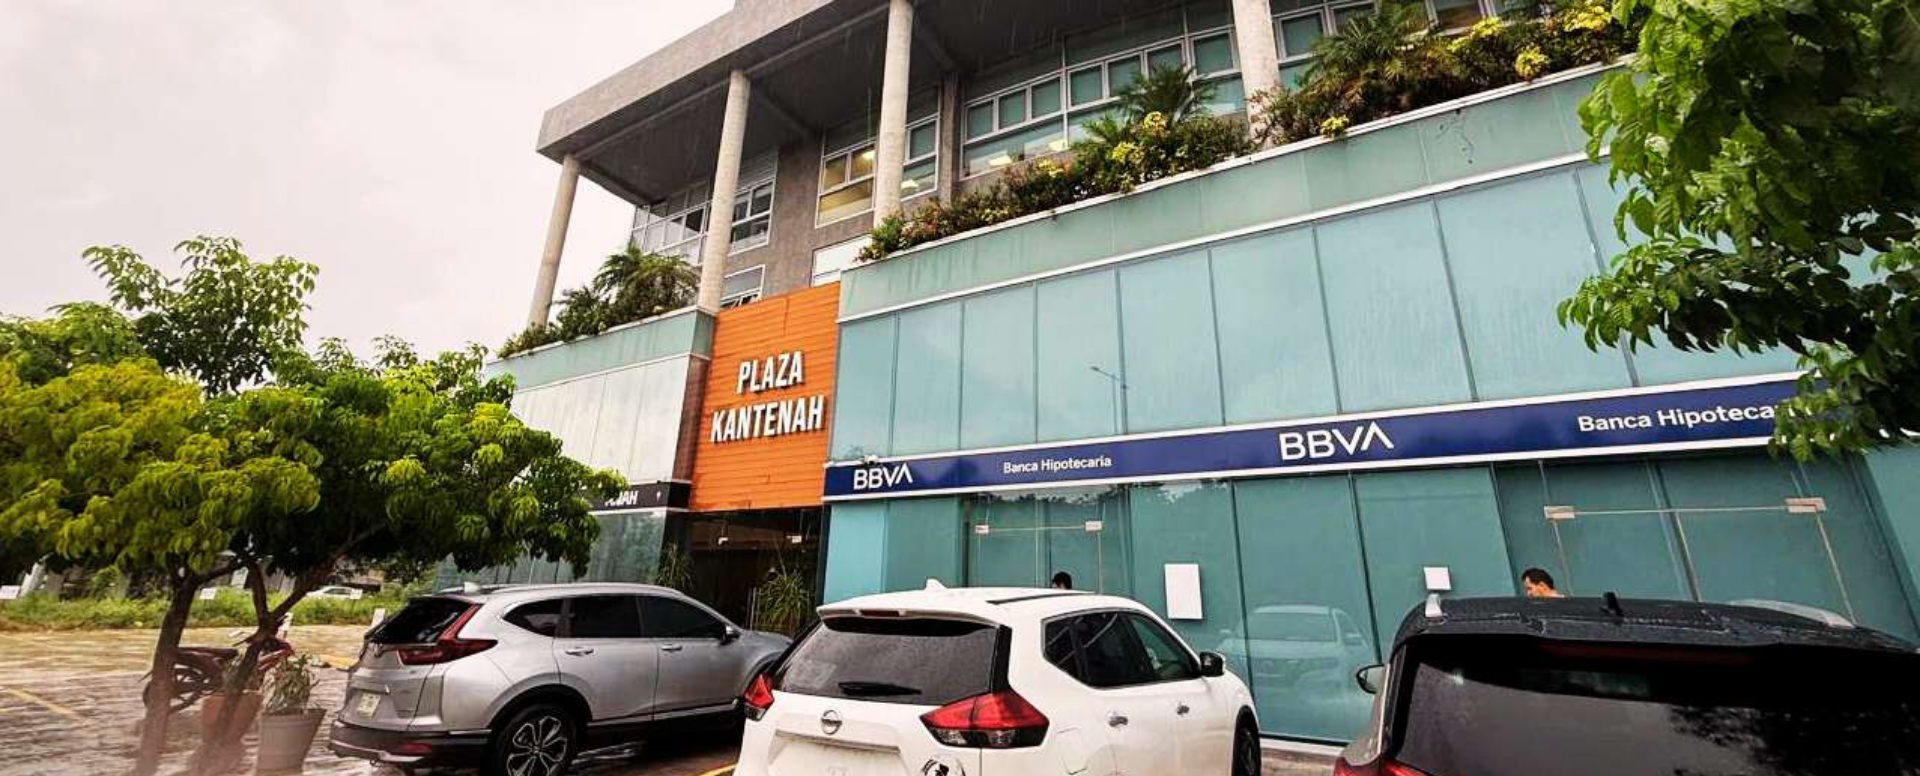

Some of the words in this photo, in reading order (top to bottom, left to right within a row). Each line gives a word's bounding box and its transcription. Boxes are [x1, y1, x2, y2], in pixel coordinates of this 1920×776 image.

[736, 351, 804, 394] PLAZA
[710, 394, 825, 443] KANTENAH
[1578, 413, 1651, 432] Banca
[1657, 403, 1813, 429] Hipoteca
[1279, 421, 1394, 460] BBVA
[853, 463, 913, 490] BBVA
[1003, 461, 1039, 474] Banca
[1041, 455, 1112, 472] Hipotecaria
